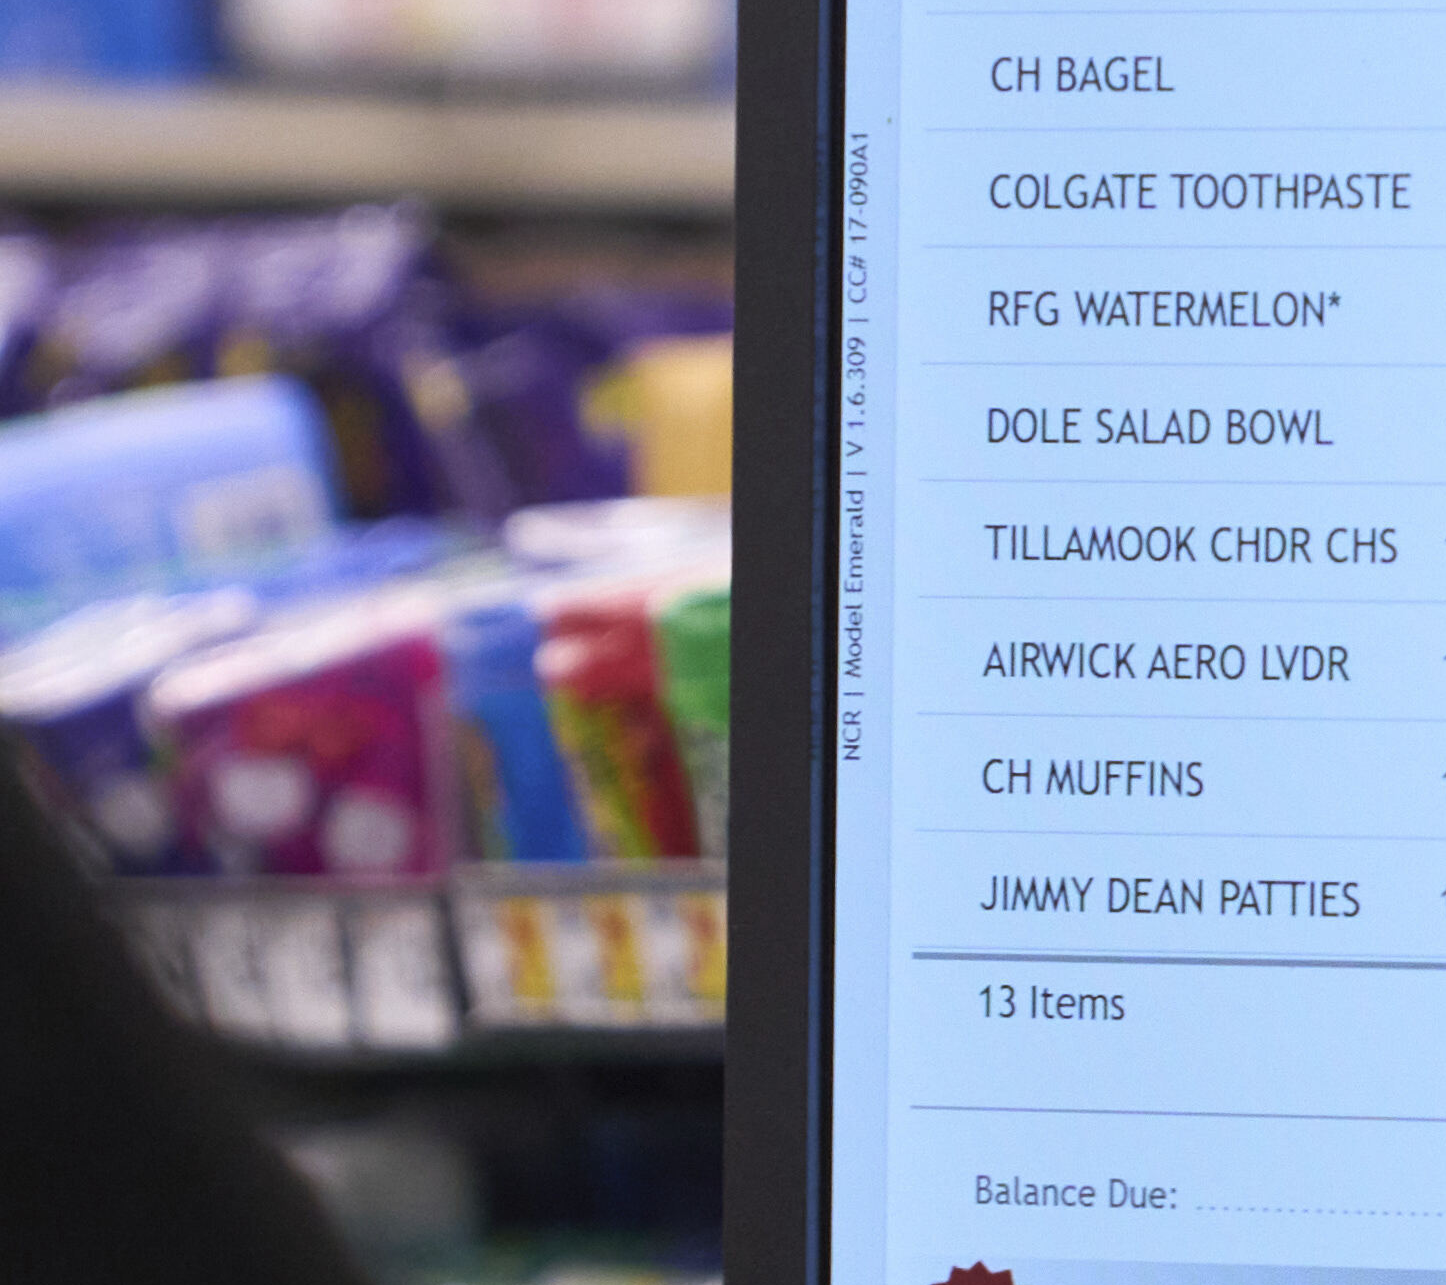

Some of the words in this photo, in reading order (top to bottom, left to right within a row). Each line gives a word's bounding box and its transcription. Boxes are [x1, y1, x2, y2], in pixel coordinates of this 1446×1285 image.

[991, 57, 1040, 92] CH
[1057, 56, 1174, 92] BAGEL
[849, 132, 869, 243] 17-090A1
[990, 173, 1157, 209] COLGATE
[1170, 173, 1411, 209] TOOTHPASTE
[847, 255, 868, 304] CC#
[989, 291, 1059, 326] RFG
[847, 336, 866, 428] 1.6.309
[988, 408, 1081, 444] DOLE
[1097, 408, 1211, 444] SALAD
[1227, 409, 1333, 445] BOWL
[844, 490, 865, 593] Emerald
[985, 525, 1196, 562] TILLAMOOK
[1211, 527, 1311, 563] CHDR
[1326, 528, 1397, 563] CHS
[844, 604, 863, 679] Model
[983, 642, 1135, 678] AIRWICK
[1147, 644, 1245, 680] AERO
[1262, 645, 1349, 681] LVDR
[843, 709, 862, 761] NCR
[983, 758, 1031, 794] CH
[1046, 760, 1203, 797] MUFFINS
[981, 876, 1093, 912] JIMMY
[1108, 877, 1203, 914] DEAN
[1221, 879, 1360, 917] PATTIES
[980, 984, 1015, 1018] 13
[1031, 986, 1125, 1021] Items
[976, 1175, 1096, 1207] Balance
[1109, 1178, 1176, 1209] Due:
